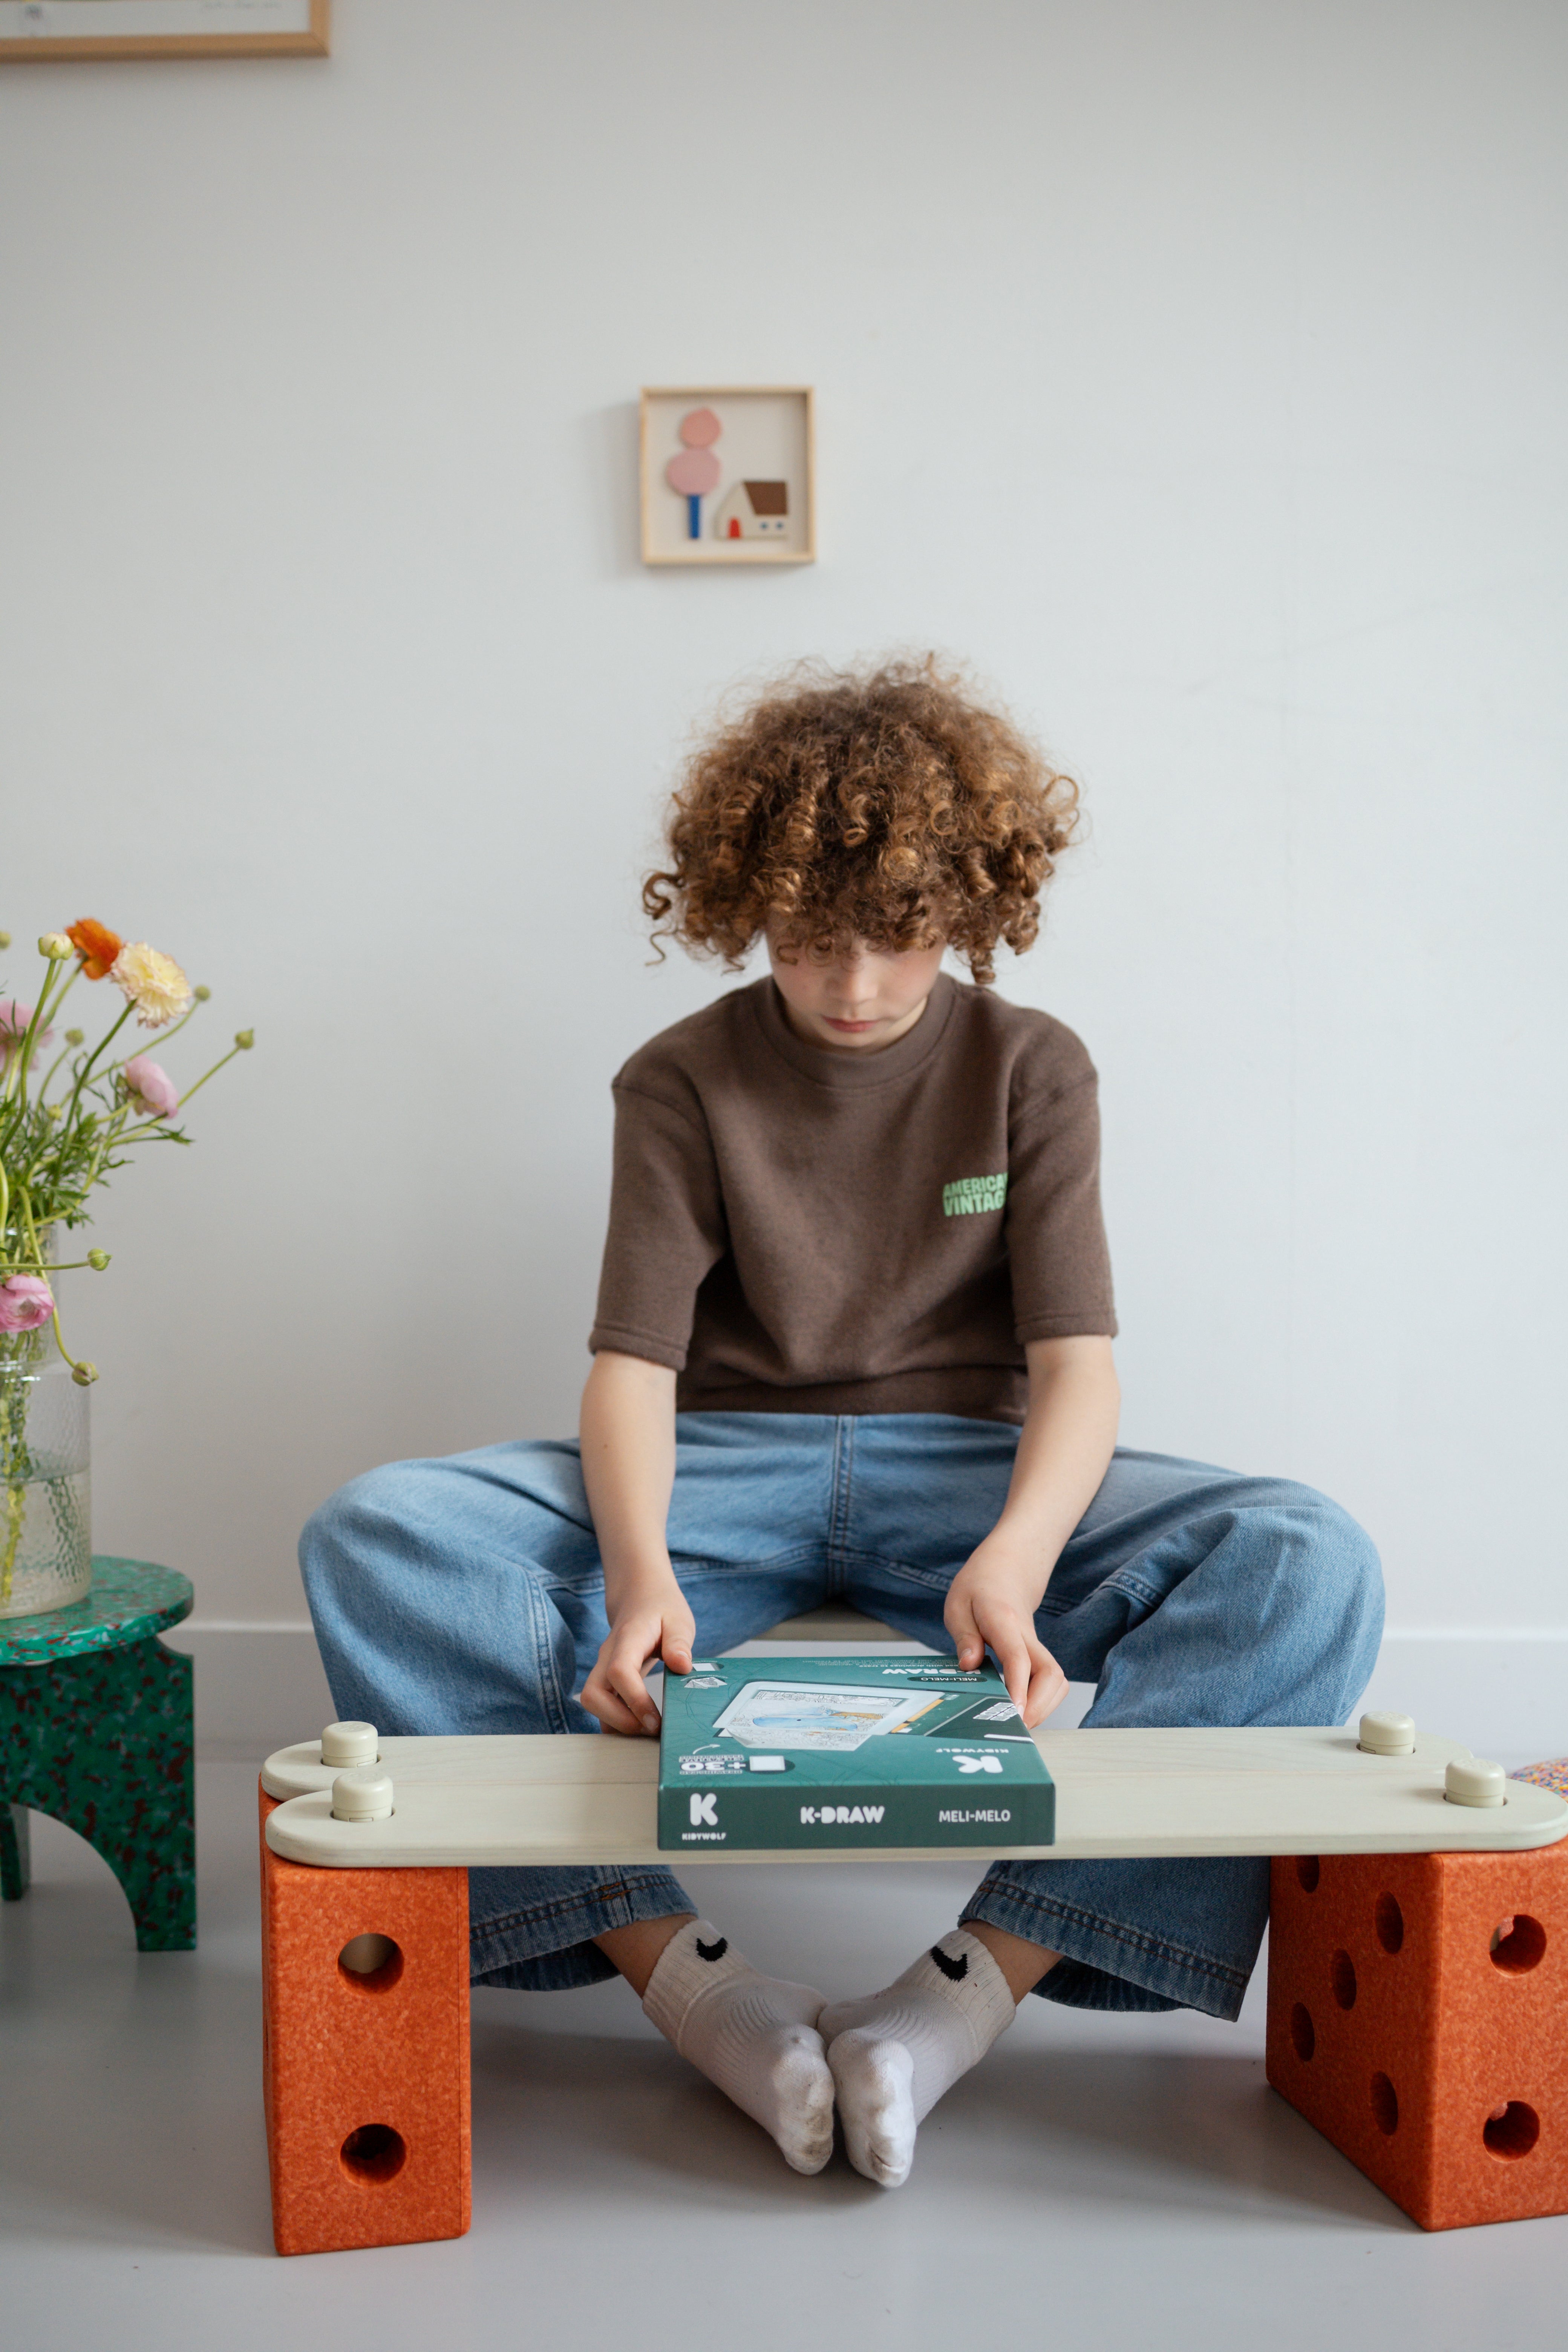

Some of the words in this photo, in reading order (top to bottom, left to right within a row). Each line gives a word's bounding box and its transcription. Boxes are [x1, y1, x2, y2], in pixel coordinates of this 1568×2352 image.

[943, 1190, 1006, 1217] VINTAG
[681, 1762, 746, 1771] +30
[952, 1755, 1003, 1773] K
[690, 1793, 718, 1826] K
[800, 1805, 885, 1824] K-DRAW
[939, 1809, 1011, 1822] MELI-MELO
